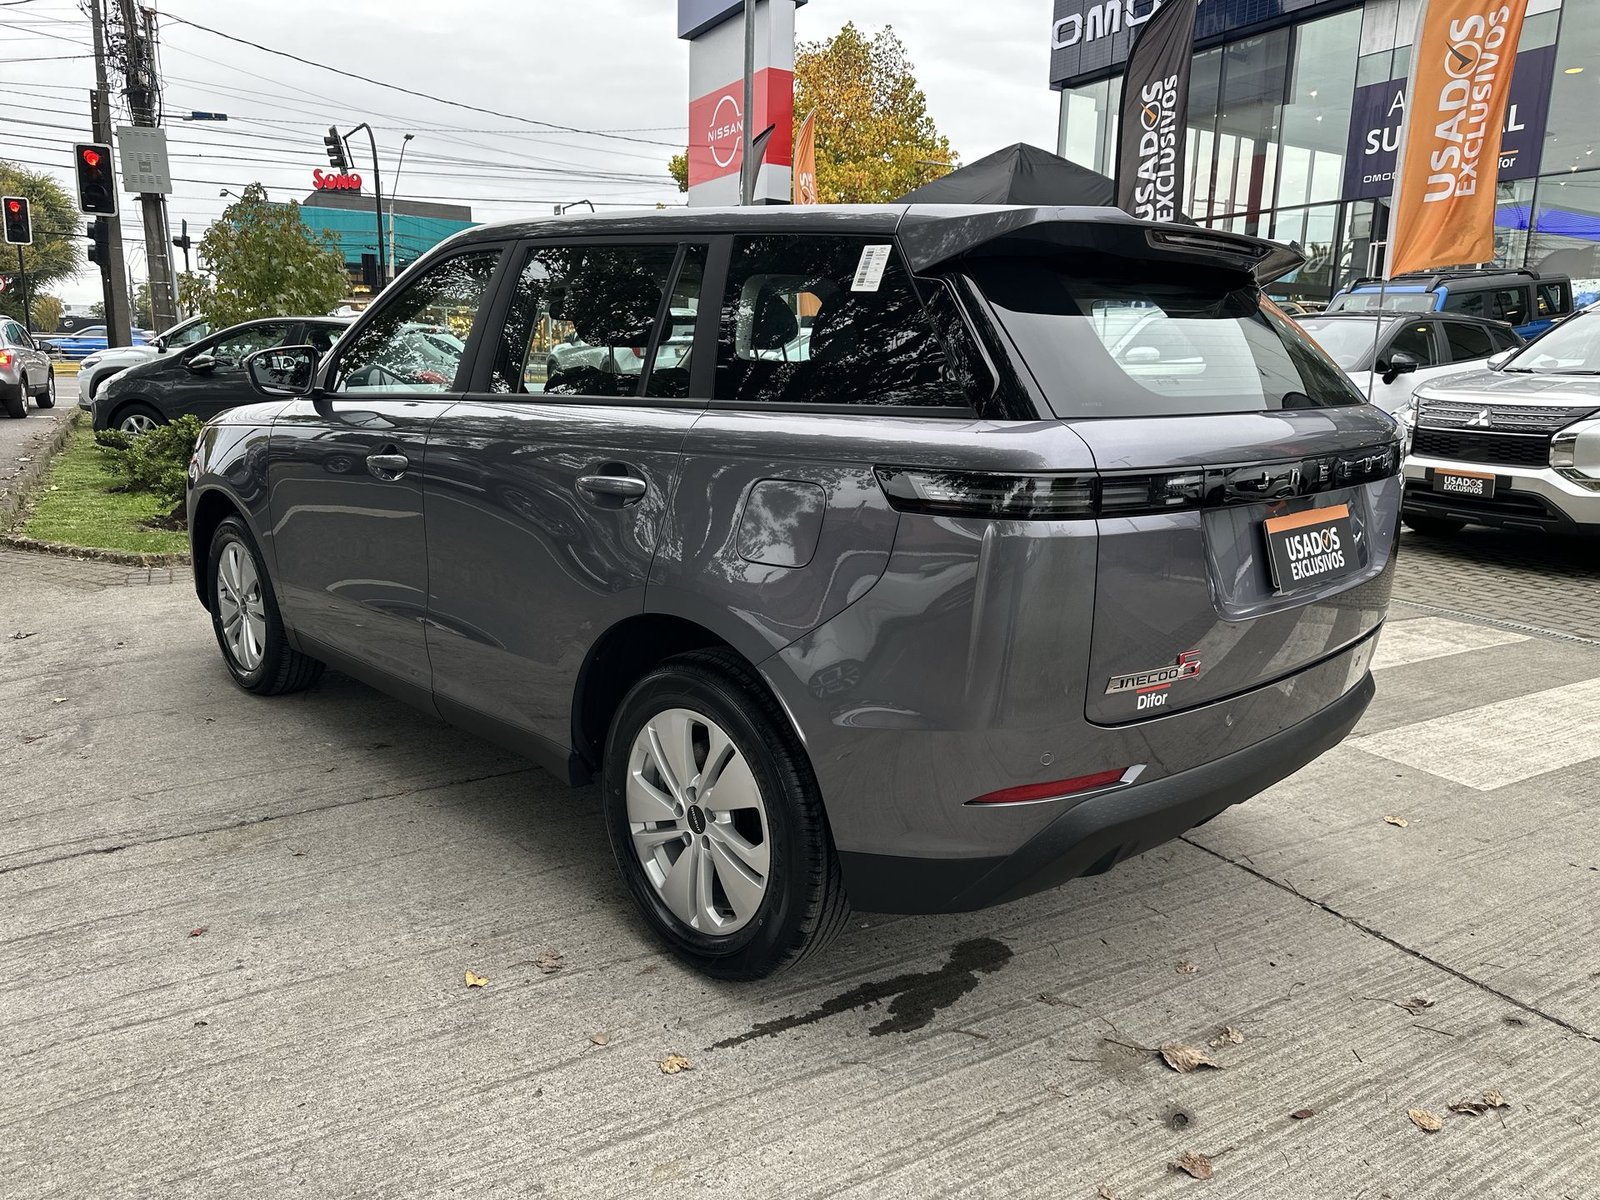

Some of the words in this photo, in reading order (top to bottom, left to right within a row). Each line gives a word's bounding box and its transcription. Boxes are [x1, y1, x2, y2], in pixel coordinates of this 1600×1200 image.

[1424, 14, 1485, 203] USADOS
[1454, 5, 1510, 197] EXCLUSIVOS
[708, 119, 744, 142] NISSAN
[1135, 80, 1163, 221] USADOS
[1156, 74, 1178, 222] EXCLUSIVOS
[1443, 476, 1483, 488] USADOS
[1443, 484, 1483, 495] EXCLUSIVOS
[1285, 526, 1340, 561] USADOS
[1290, 550, 1345, 580] EXCLUSIVOS
[1177, 649, 1201, 680] 5
[1137, 692, 1168, 710] Difor
